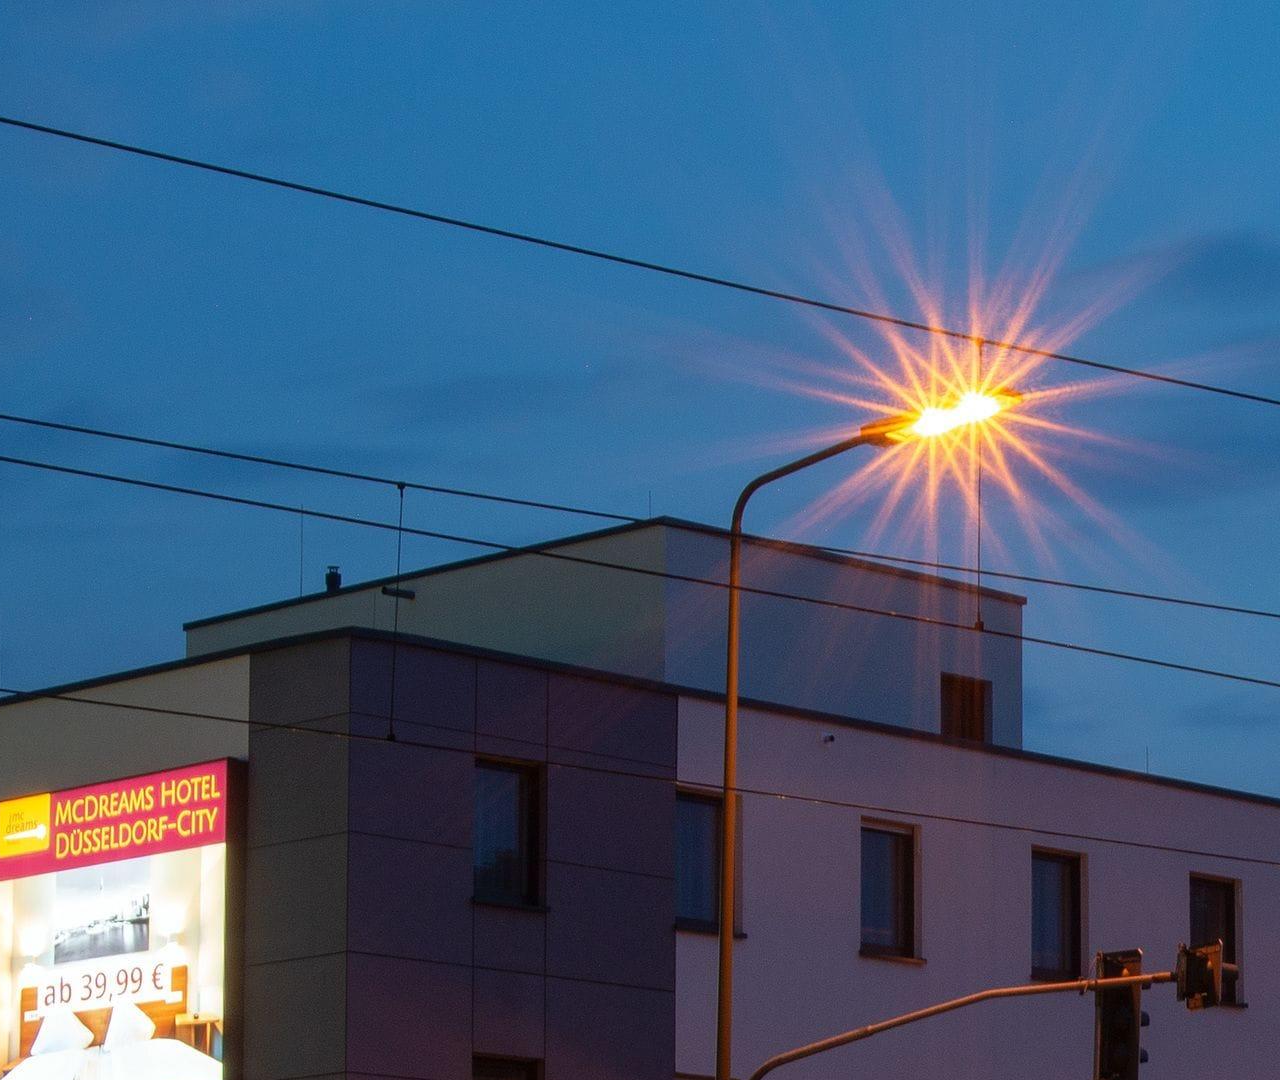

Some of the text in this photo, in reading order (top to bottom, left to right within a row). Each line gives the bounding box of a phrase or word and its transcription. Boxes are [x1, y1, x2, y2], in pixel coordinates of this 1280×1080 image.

[55, 775, 220, 826] MCDREAMS HOTEL
[55, 807, 218, 859] DÜSSELDORF-CITY
[45, 963, 164, 1006] ab 39,99 €
